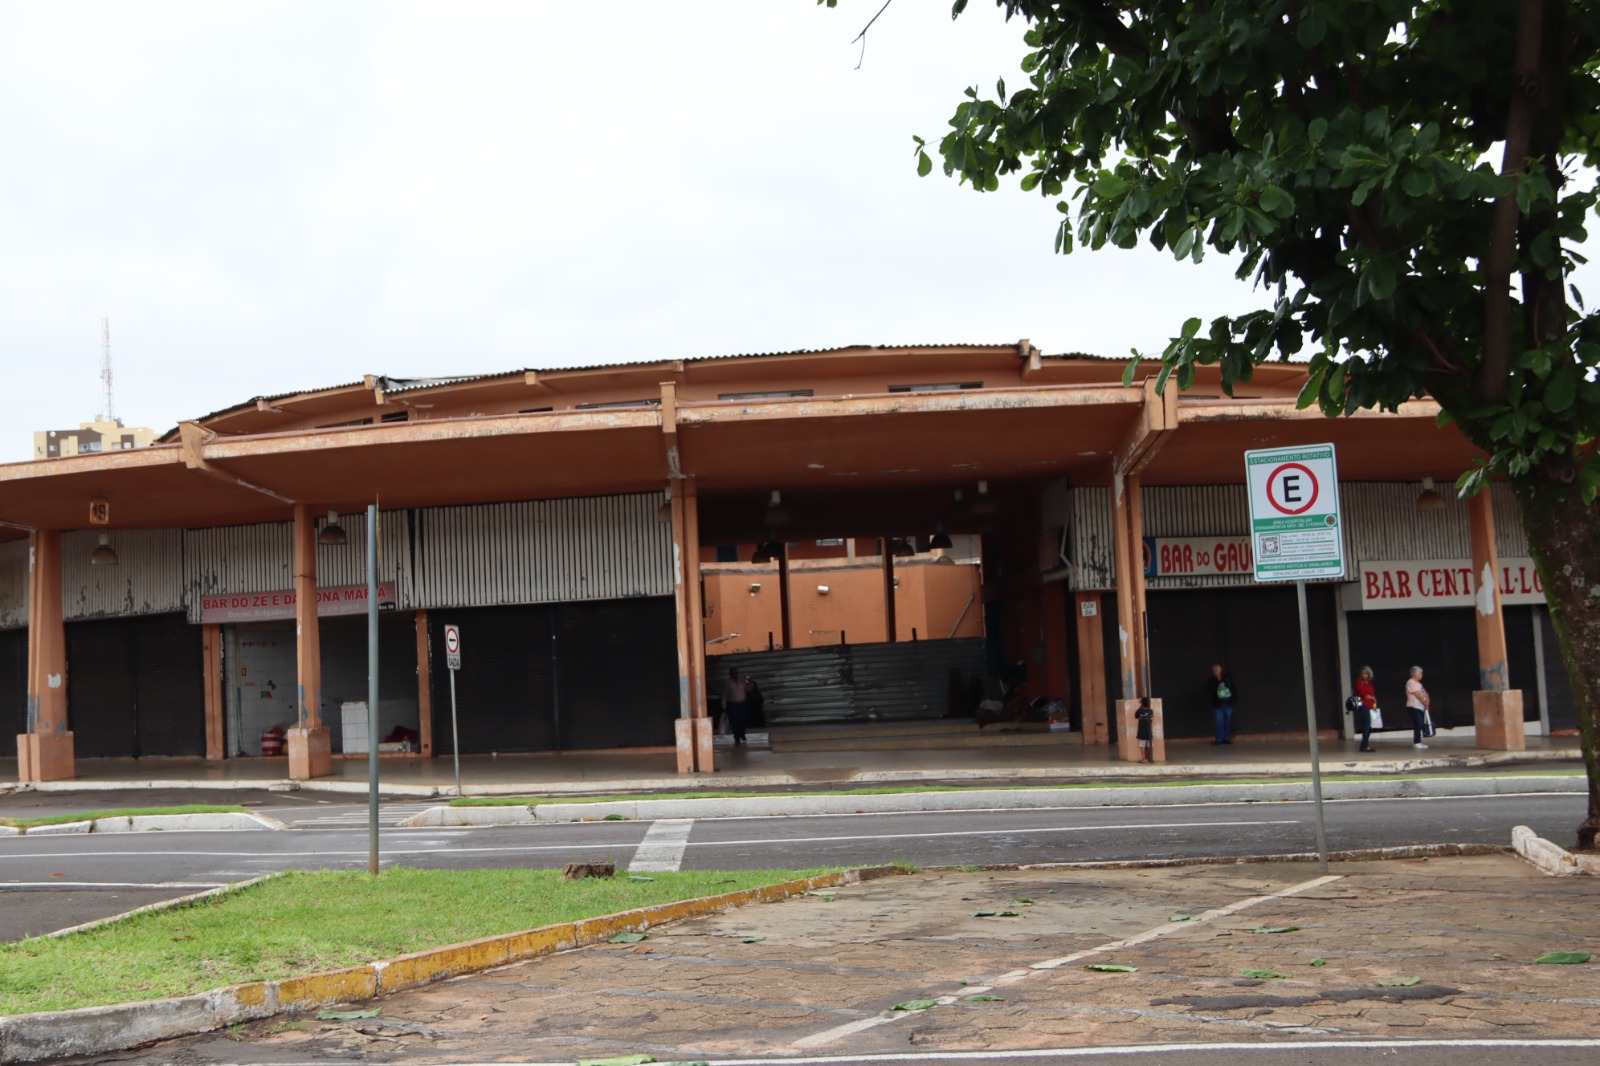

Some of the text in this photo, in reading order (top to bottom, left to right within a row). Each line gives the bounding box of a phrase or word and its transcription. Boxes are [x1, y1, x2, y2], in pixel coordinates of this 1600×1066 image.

[1250, 451, 1330, 464] ESTACIONAMENTO ROTATIVO
[1283, 475, 1301, 502] E
[1161, 538, 1253, 573] BAR DO GAÚ
[1364, 570, 1411, 599] BAR
[1417, 567, 1515, 596] CENTL
[203, 597, 227, 609] BAR
[231, 597, 249, 608] DO
[253, 596, 267, 607] ZE
[273, 595, 280, 606] E
[316, 591, 340, 603] ONA
[344, 587, 386, 601] MAA
[255, 608, 287, 618] Salgados
[340, 603, 360, 613] geral
